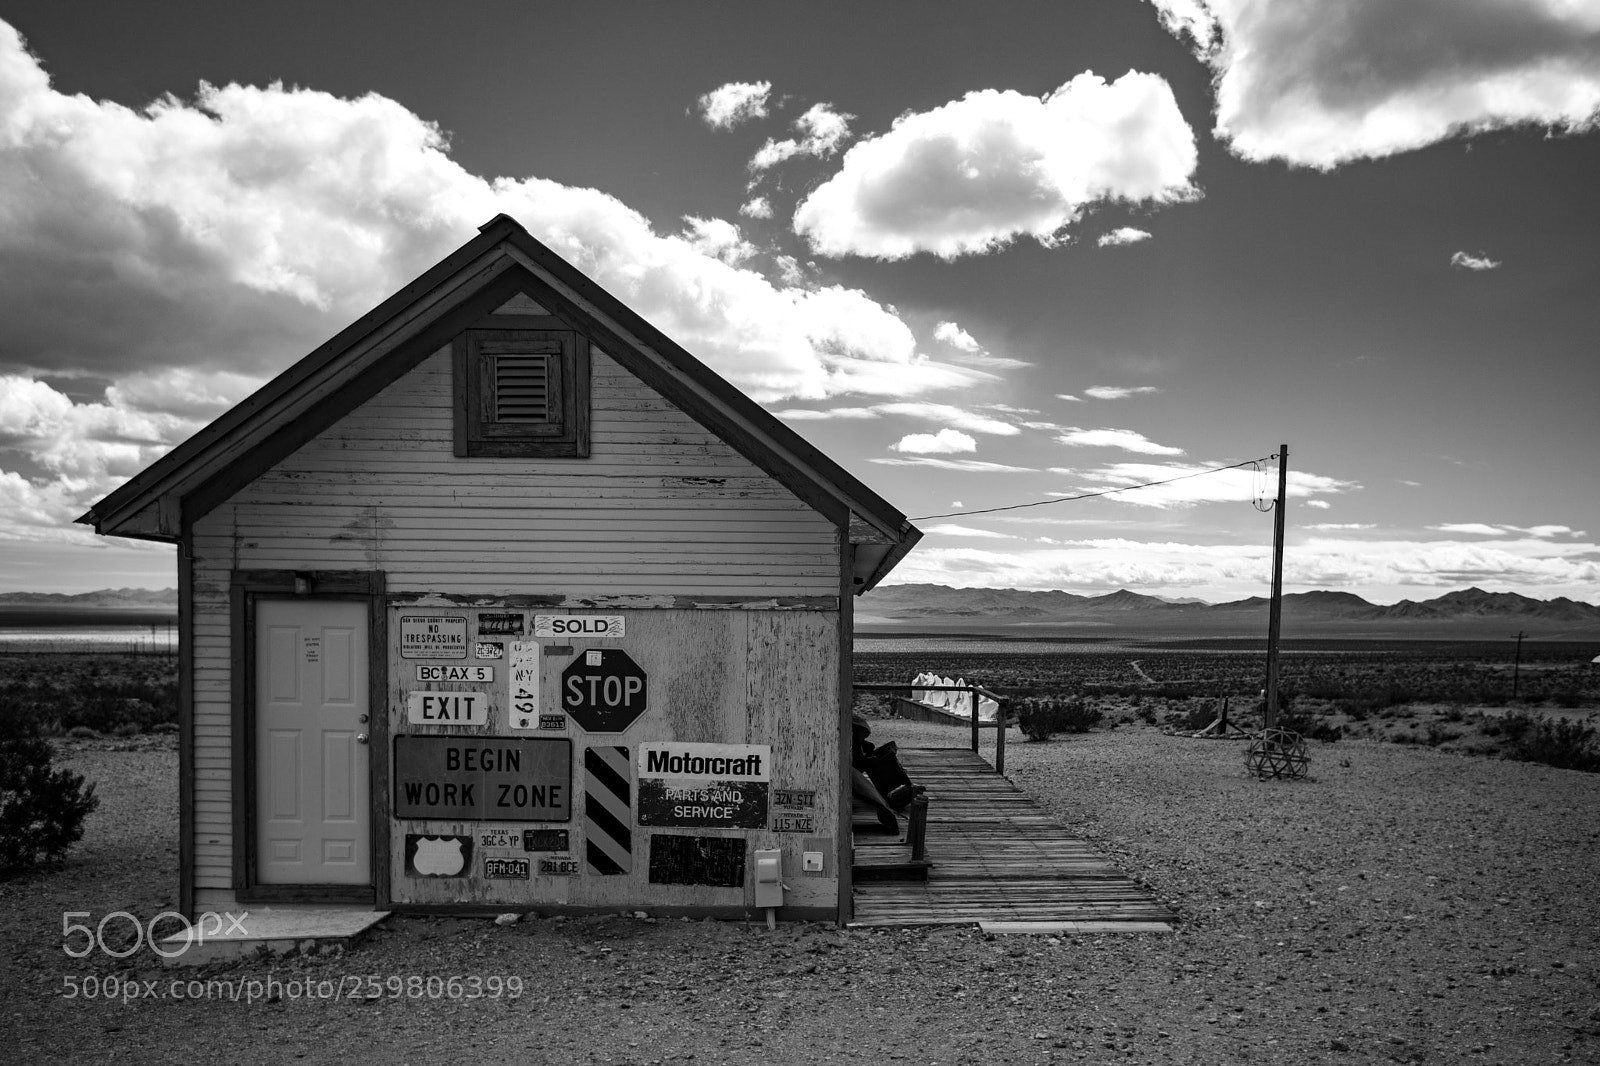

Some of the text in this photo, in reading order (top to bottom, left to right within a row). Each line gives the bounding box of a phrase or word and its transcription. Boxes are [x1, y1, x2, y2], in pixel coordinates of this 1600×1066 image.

[428, 624, 438, 633] NO
[552, 620, 608, 633] SOLD
[406, 634, 462, 643] TRESPASSING
[421, 667, 485, 680] BC AX 5
[566, 675, 642, 706] STOP
[423, 697, 475, 720] EXIT
[446, 748, 520, 772] BEGIN
[648, 750, 762, 776] Motorcraft
[404, 782, 562, 808] WORK ZONE
[665, 789, 742, 802] PARTS AND
[674, 806, 733, 819] SERVICE
[481, 836, 519, 846] 3GC YP
